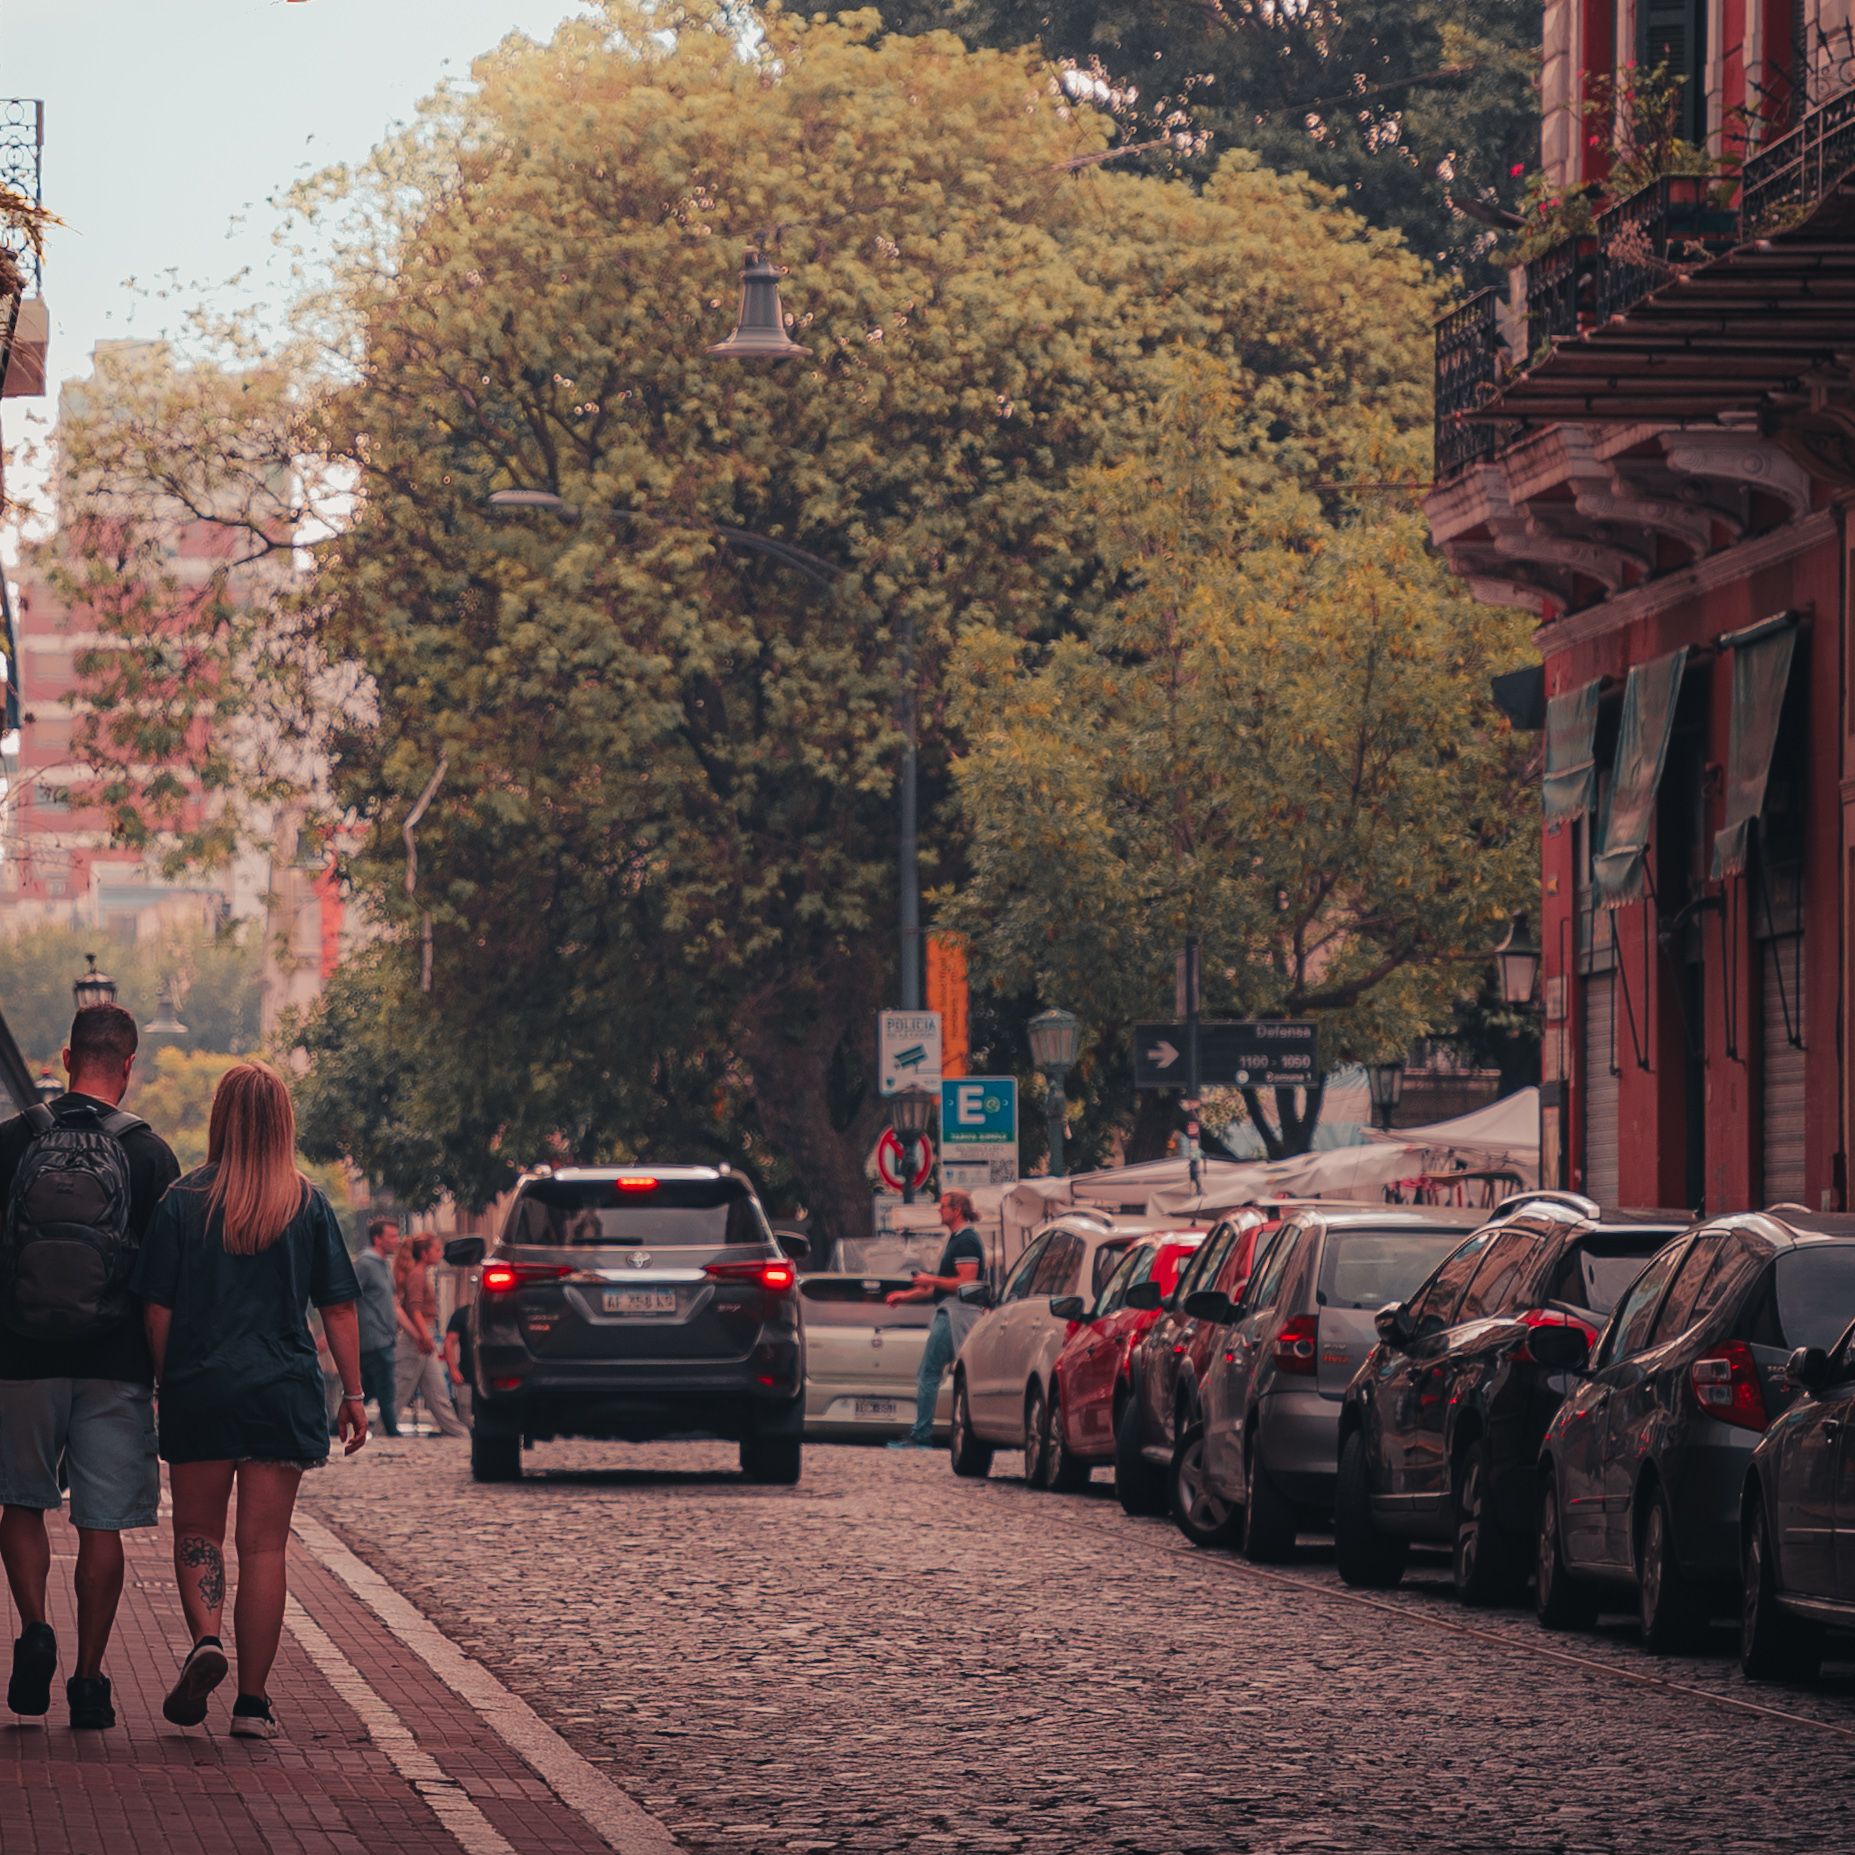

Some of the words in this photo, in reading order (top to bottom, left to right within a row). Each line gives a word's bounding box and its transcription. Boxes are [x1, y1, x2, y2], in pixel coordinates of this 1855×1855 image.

[1256, 1025, 1312, 1039] Defensa
[1239, 1055, 1269, 1069] 1100
[957, 1085, 986, 1125] E
